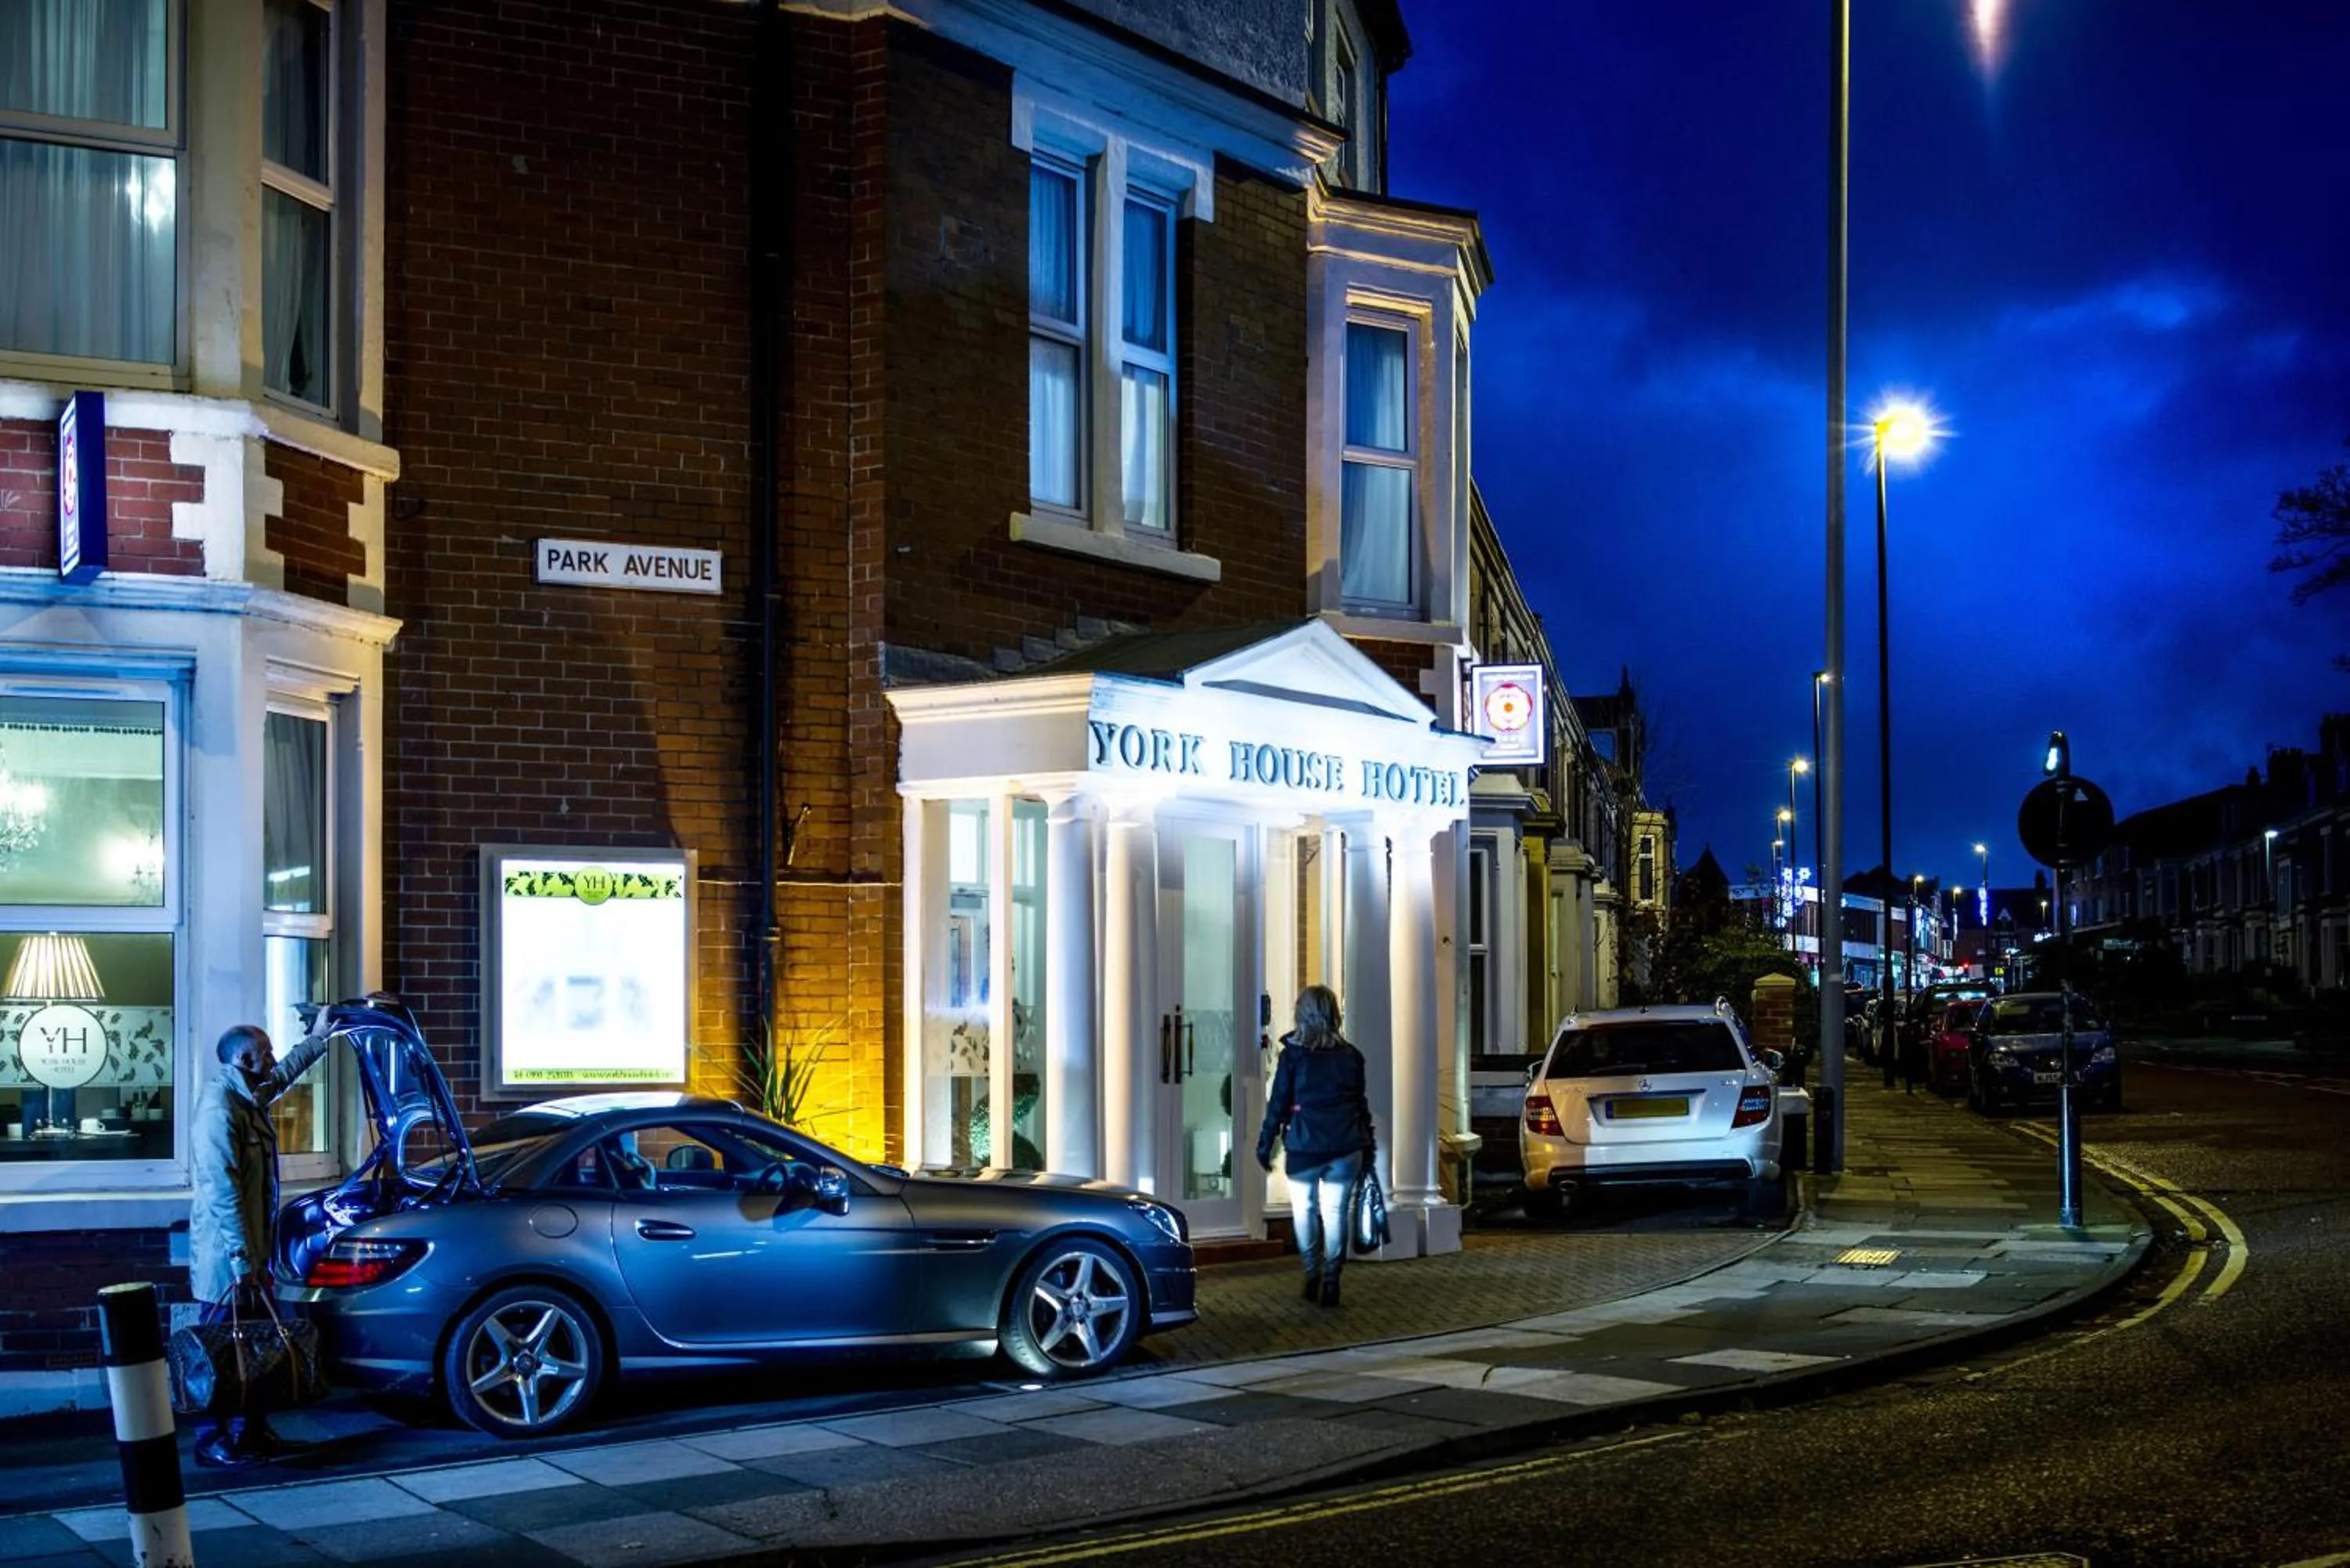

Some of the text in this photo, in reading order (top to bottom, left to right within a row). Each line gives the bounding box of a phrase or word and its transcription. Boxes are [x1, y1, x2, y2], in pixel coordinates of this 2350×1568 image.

[548, 548, 713, 580] PARK AVENUE
[1089, 720, 1466, 808] YORK HOUSE HOTEL
[584, 874, 606, 890] YH
[39, 1026, 88, 1054] YH
